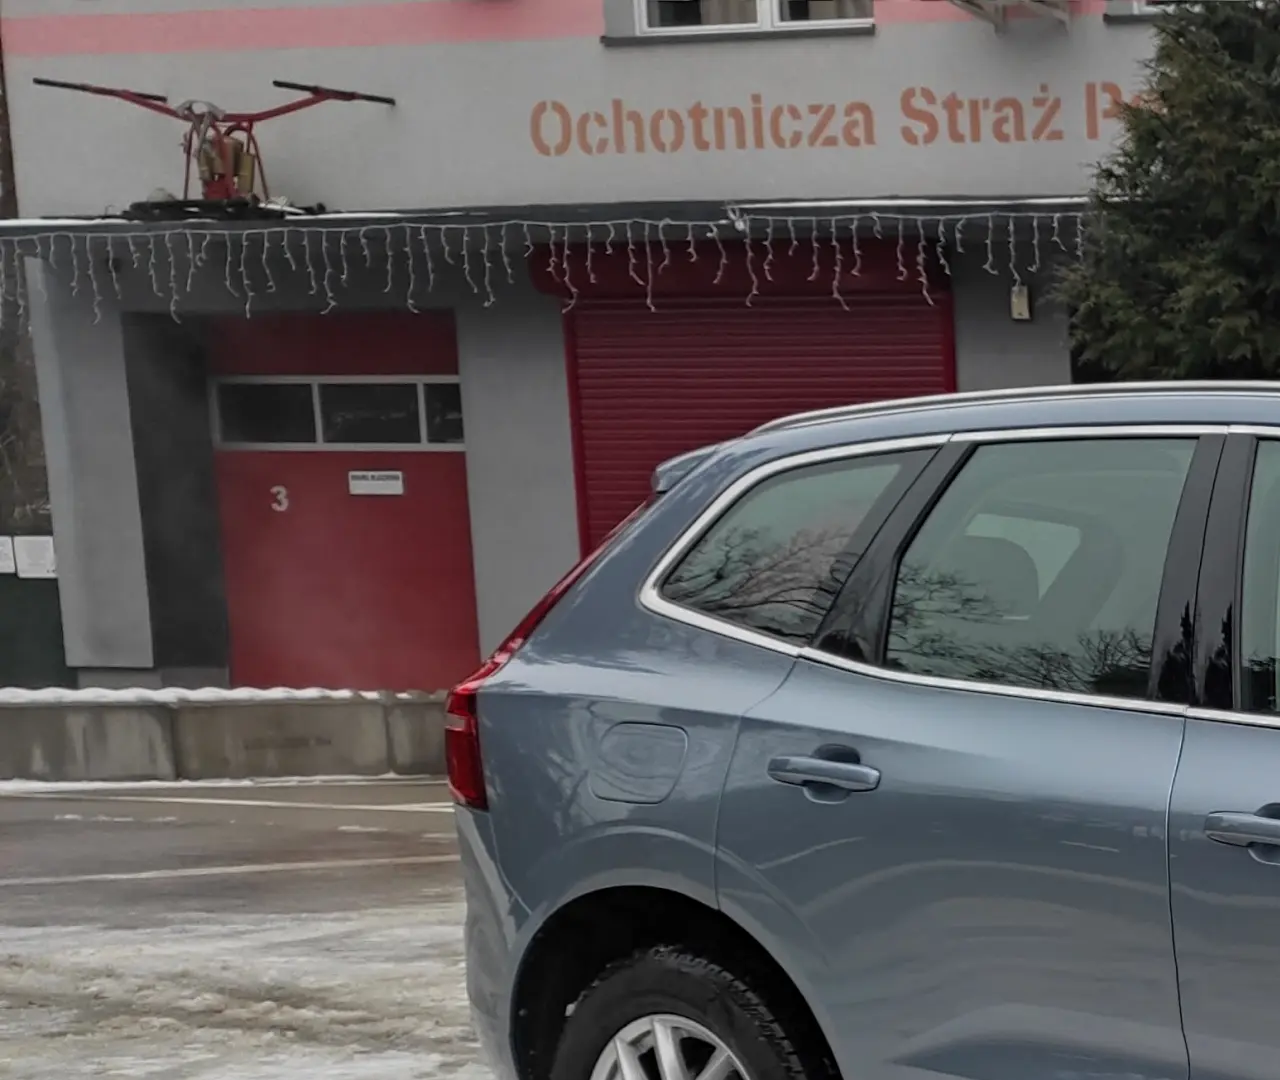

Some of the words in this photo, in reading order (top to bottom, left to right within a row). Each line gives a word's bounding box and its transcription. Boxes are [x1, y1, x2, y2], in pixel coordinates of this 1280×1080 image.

[529, 93, 876, 157] Ochotnicza
[899, 82, 1064, 146] Straż
[269, 485, 290, 512] 3
